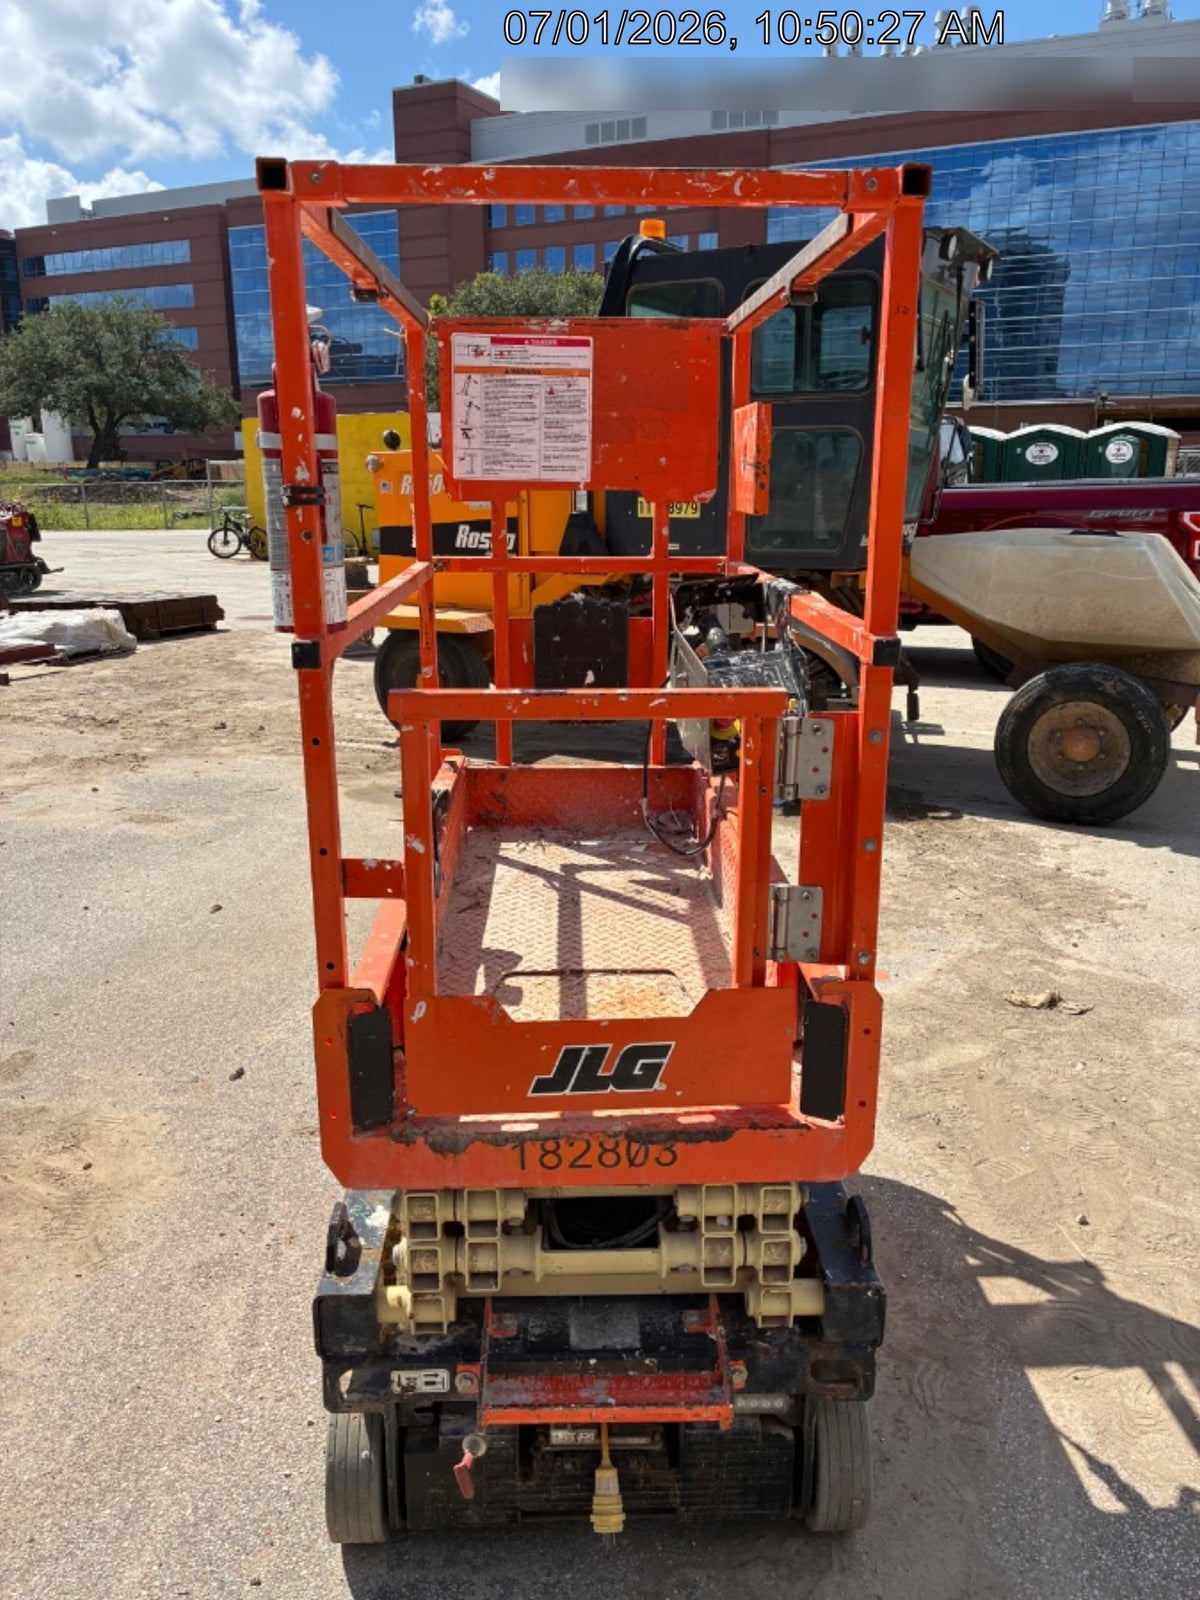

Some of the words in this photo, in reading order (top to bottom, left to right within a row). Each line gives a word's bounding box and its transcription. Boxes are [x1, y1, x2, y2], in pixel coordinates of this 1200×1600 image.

[455, 524, 516, 551] Roso
[527, 1042, 675, 1097] JLG
[512, 1138, 677, 1170] 182803
